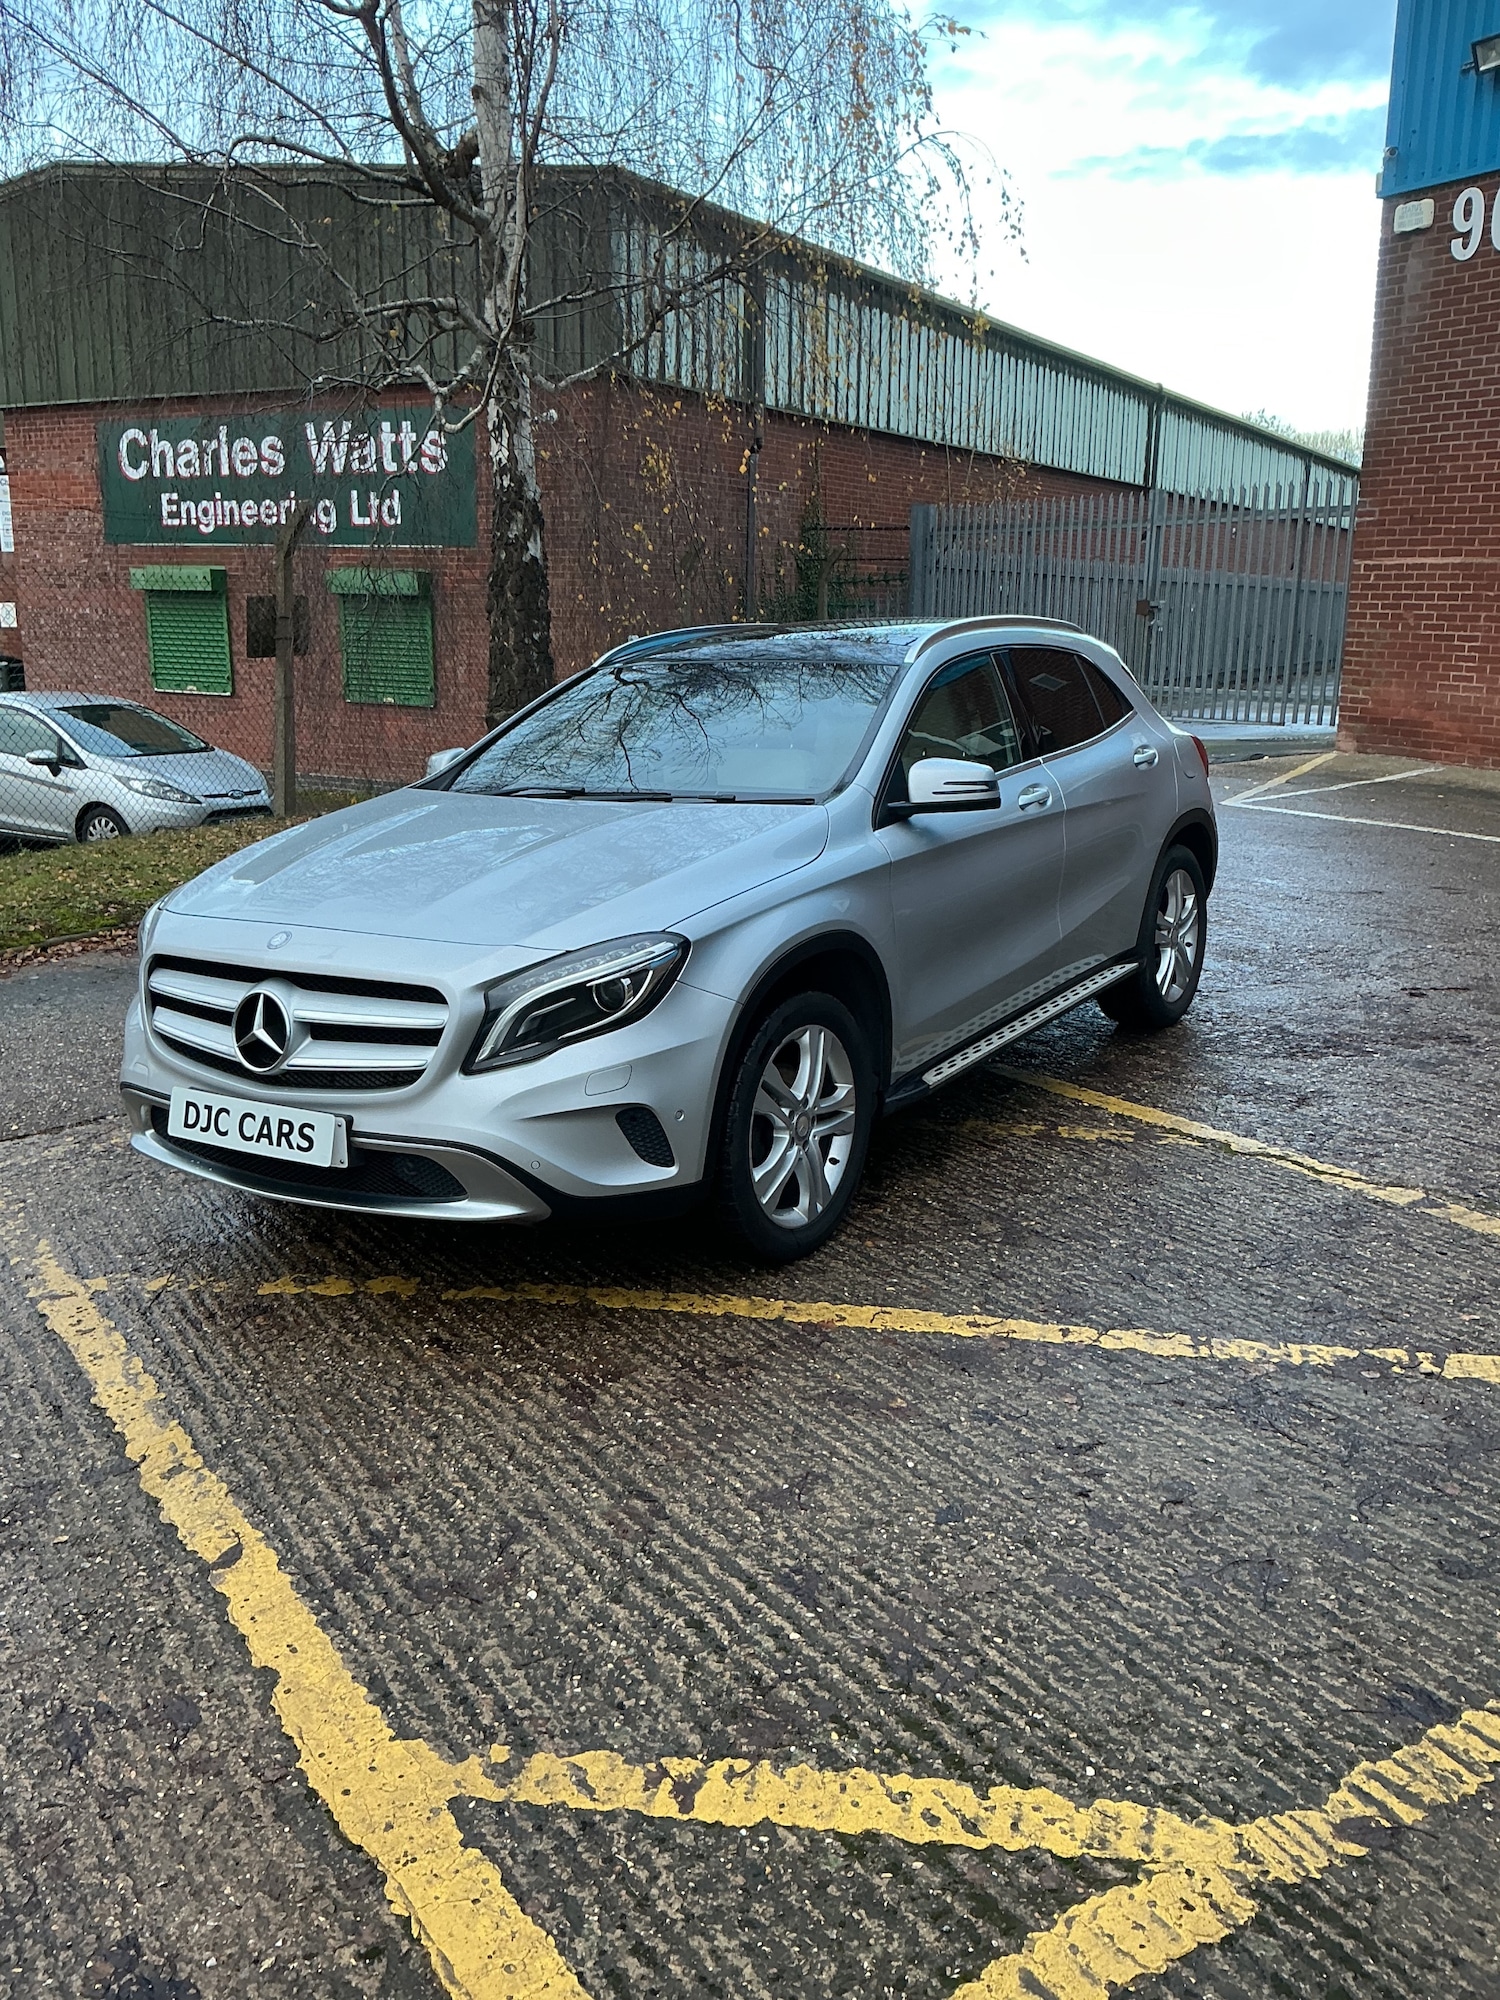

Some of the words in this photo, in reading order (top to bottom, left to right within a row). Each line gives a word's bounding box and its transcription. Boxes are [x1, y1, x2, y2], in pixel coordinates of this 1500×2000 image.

[118, 426, 286, 480] Charles
[305, 420, 448, 474] Watts
[160, 491, 337, 534] Engineerig
[350, 489, 402, 526] Ltd
[183, 1100, 231, 1137] DJC
[238, 1112, 316, 1153] CARS
